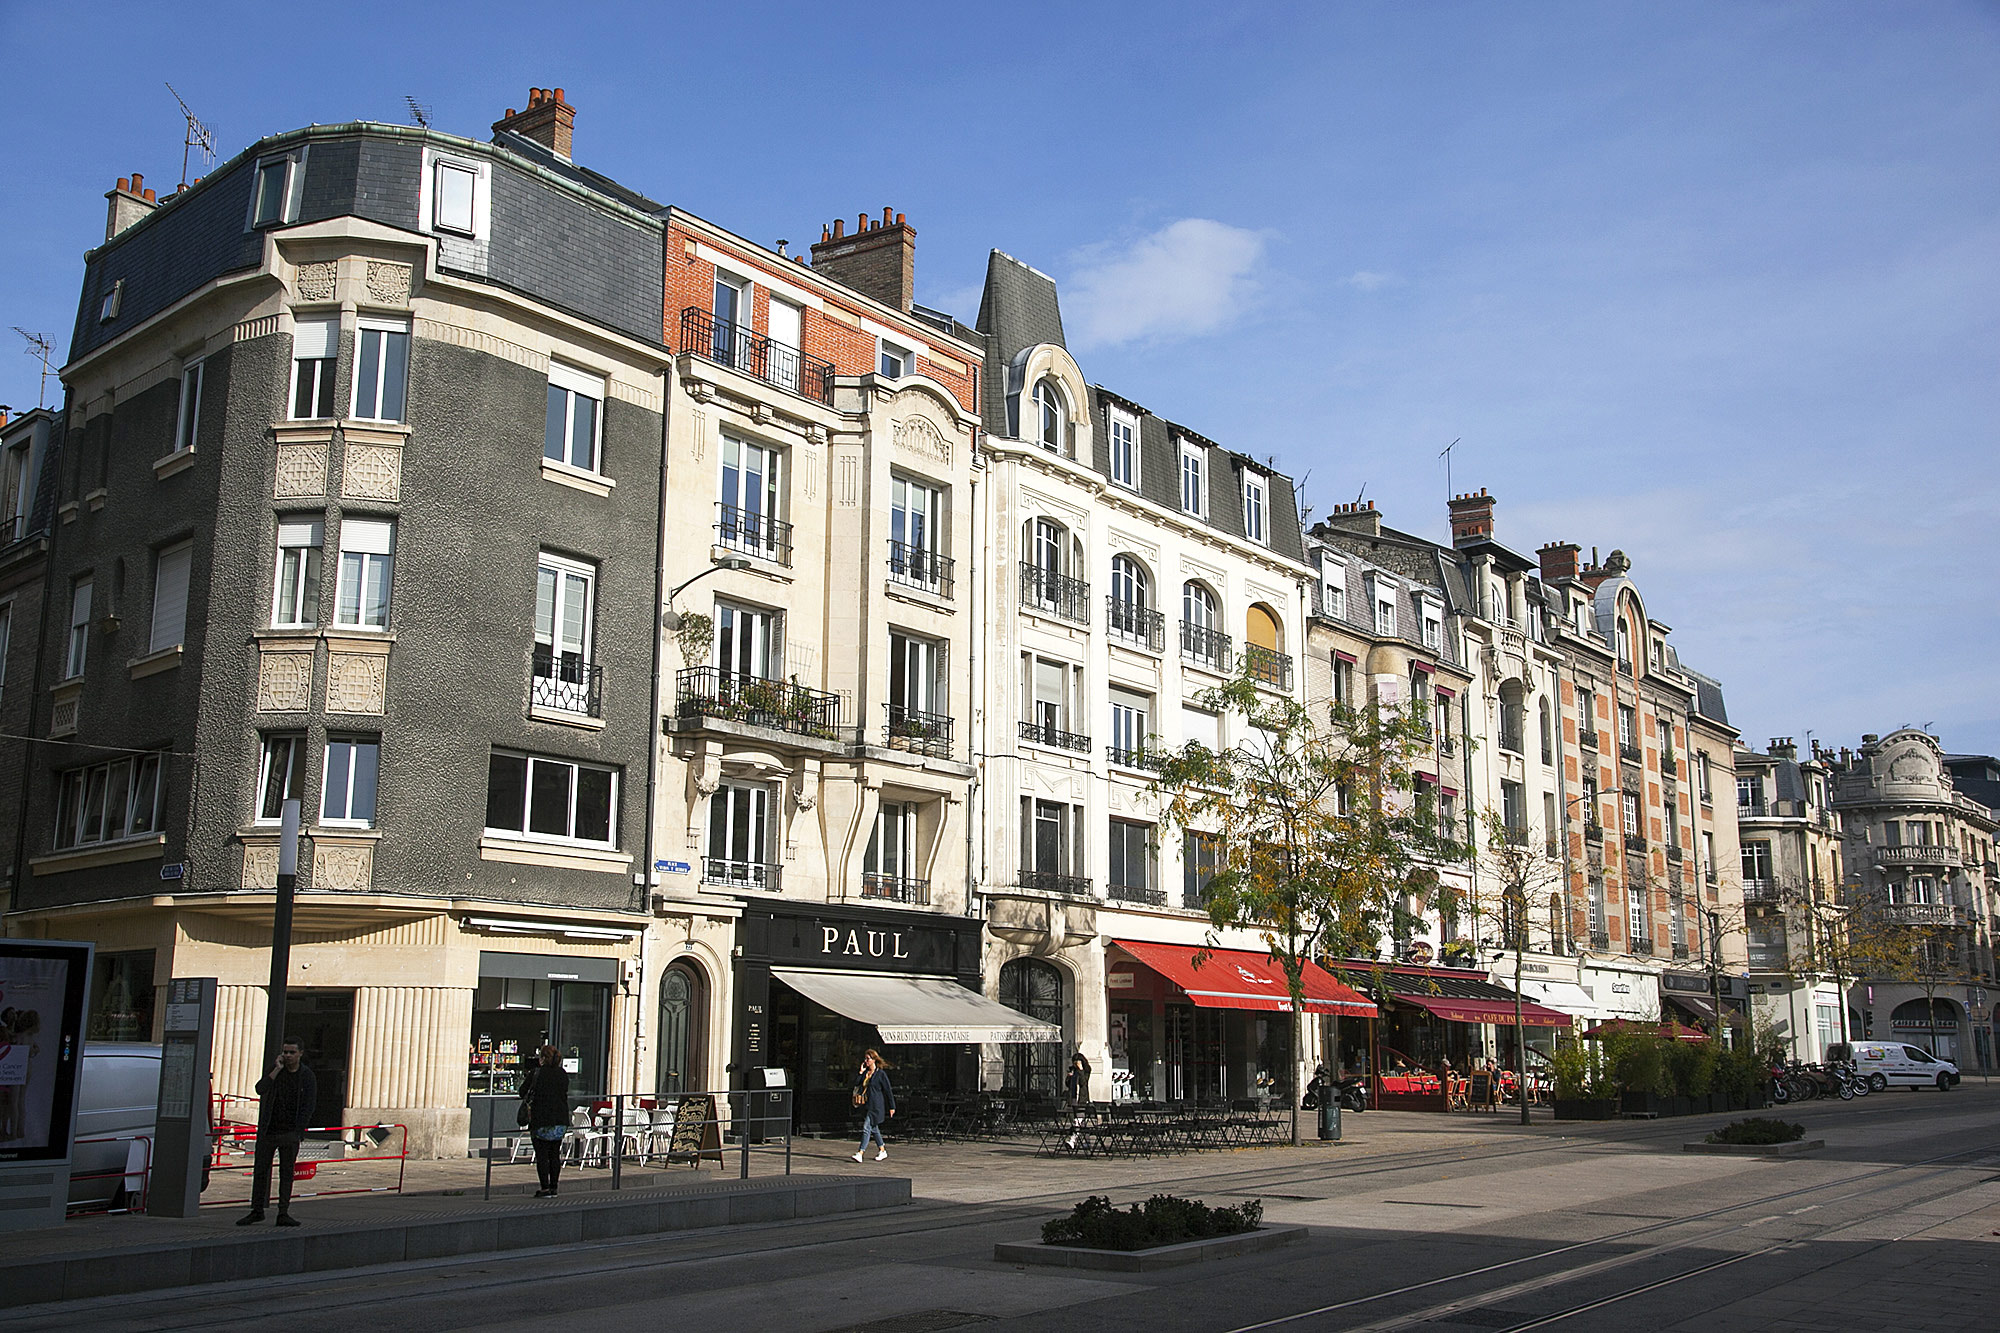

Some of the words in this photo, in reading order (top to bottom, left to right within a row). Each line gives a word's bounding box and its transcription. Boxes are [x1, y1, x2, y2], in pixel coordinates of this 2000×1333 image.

[821, 926, 909, 958] PAUL
[882, 1032, 897, 1042] PAINS
[897, 1032, 927, 1042] RUSTIQUES
[928, 1032, 934, 1042] ET
[935, 1032, 943, 1042] DE
[944, 1032, 970, 1042] FANTAISIE
